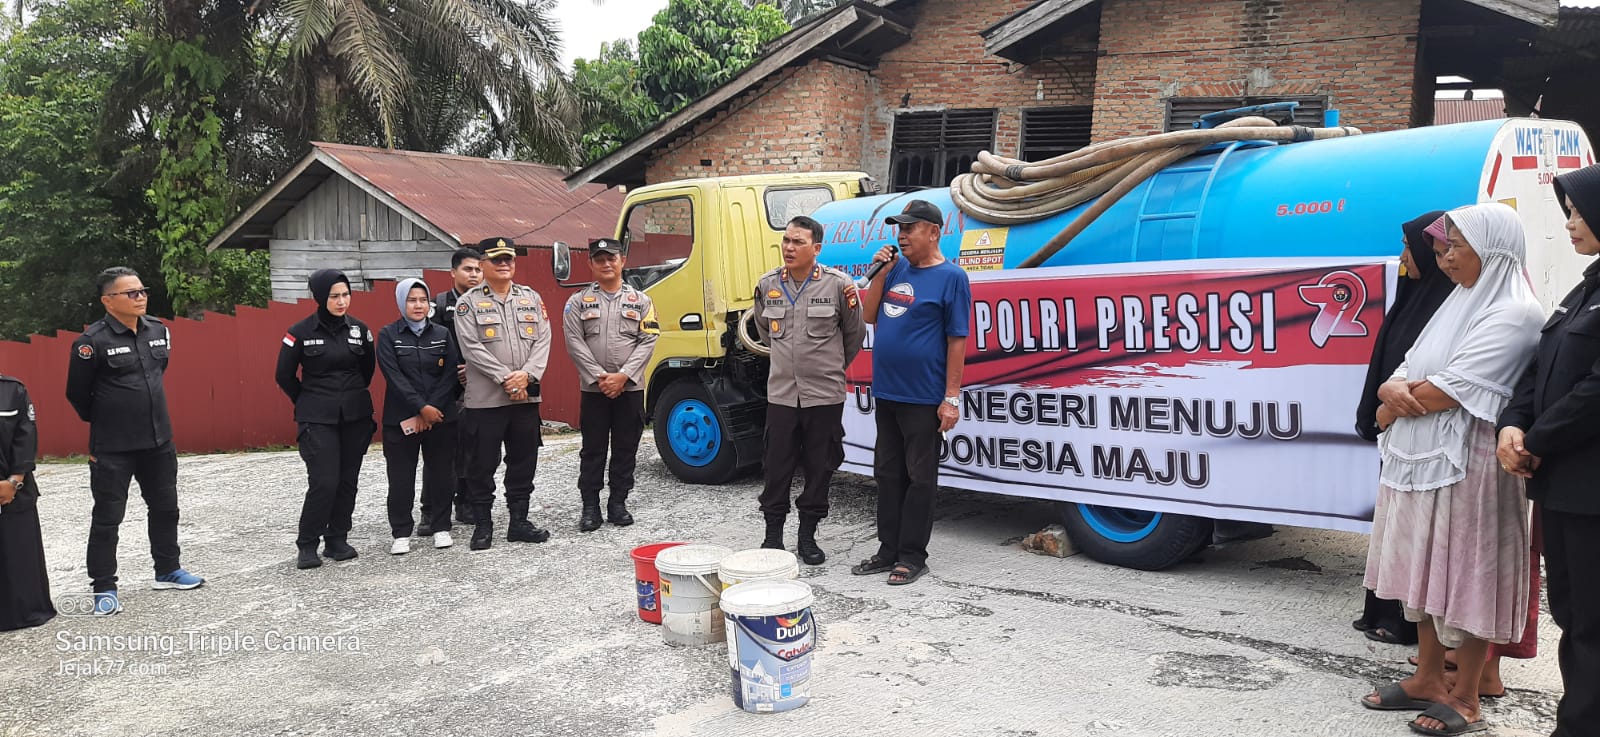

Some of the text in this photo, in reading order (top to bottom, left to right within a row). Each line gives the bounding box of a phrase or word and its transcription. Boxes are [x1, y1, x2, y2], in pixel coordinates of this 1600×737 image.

[1514, 127, 1580, 155] WATE TANK
[1276, 203, 1332, 216] 5.000
[982, 256, 1002, 264] SPOT
[974, 290, 1277, 353] POLRI PRESISI
[963, 389, 1302, 440] NEGERI MENUJU
[939, 433, 1210, 488] ONESIA MAJU
[776, 622, 810, 640] Dulux
